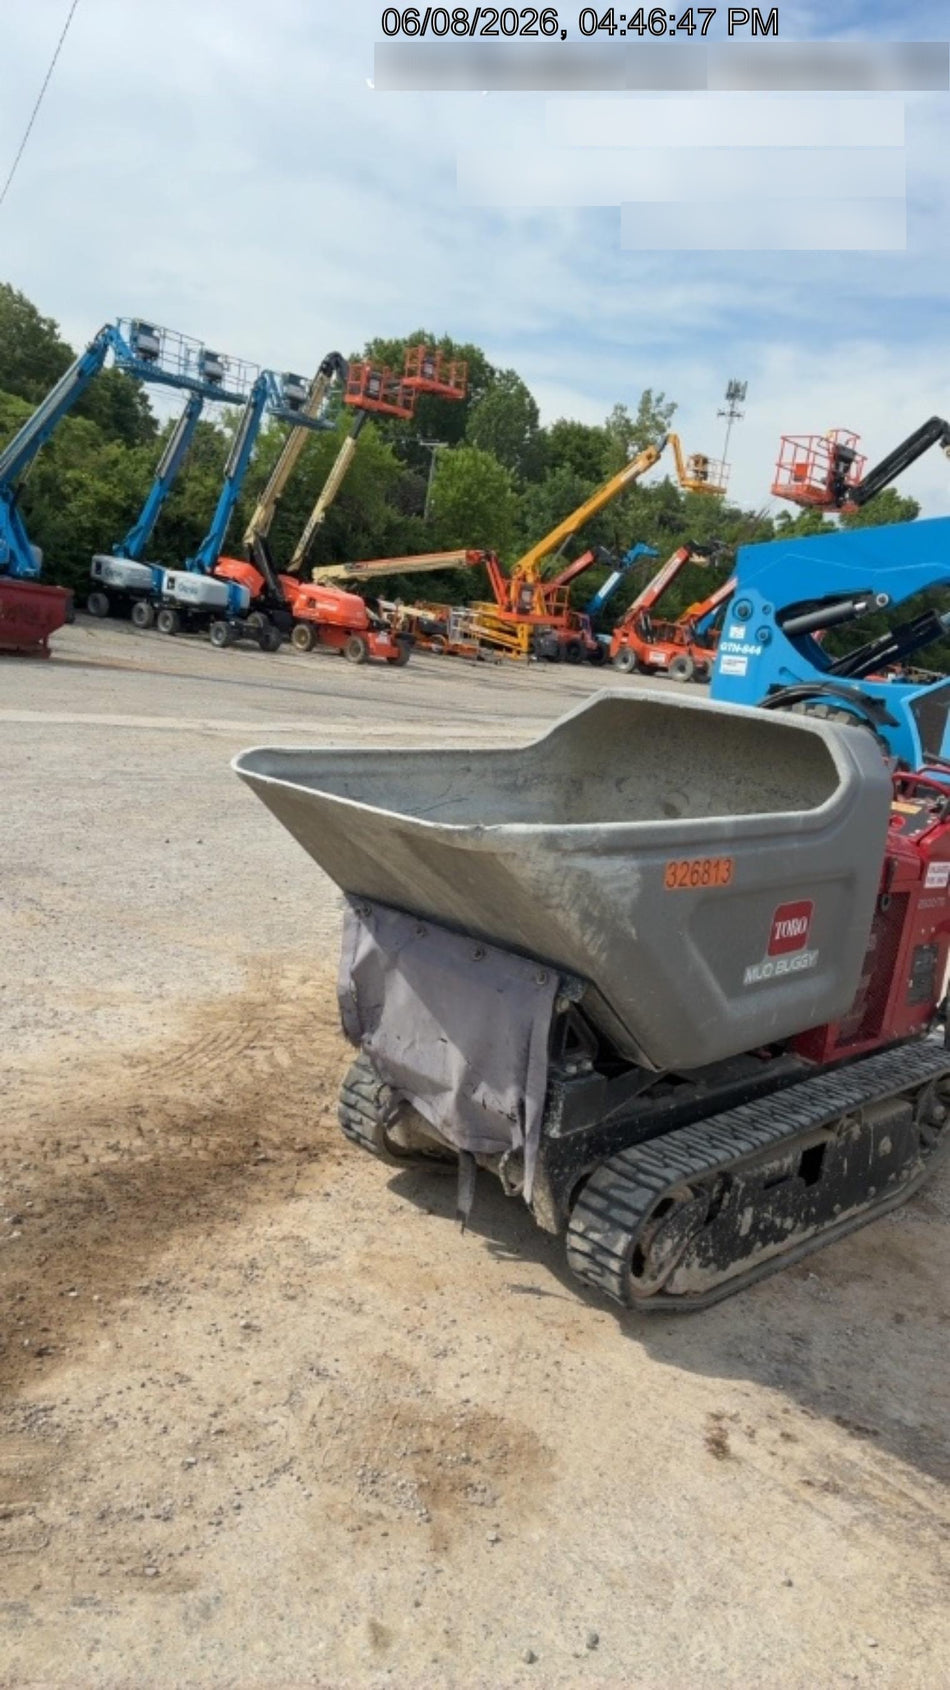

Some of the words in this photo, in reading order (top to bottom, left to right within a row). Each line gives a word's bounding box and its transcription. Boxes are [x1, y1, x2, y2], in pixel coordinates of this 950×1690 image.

[665, 857, 733, 889] 326813
[774, 915, 809, 940] TORO
[743, 962, 774, 986] MUD
[775, 949, 819, 976] BUGGY
